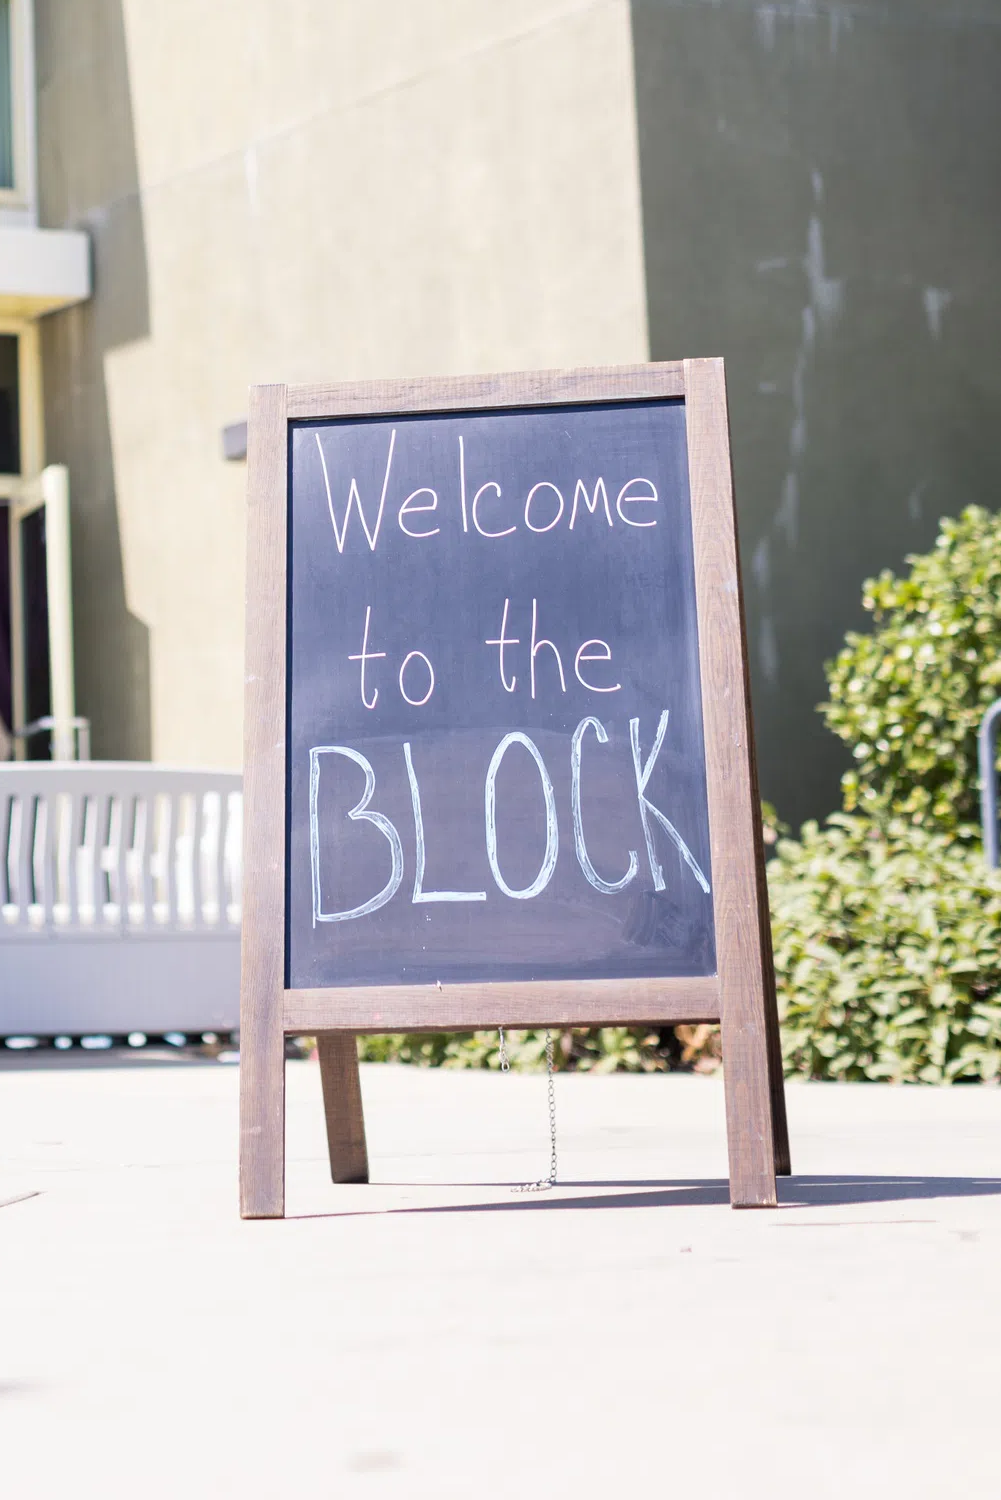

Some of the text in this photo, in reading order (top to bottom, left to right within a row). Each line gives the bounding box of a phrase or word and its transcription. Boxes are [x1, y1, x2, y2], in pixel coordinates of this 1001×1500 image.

[315, 428, 659, 553] Welcome
[348, 598, 621, 709] to the
[308, 709, 711, 929] BLOCK
